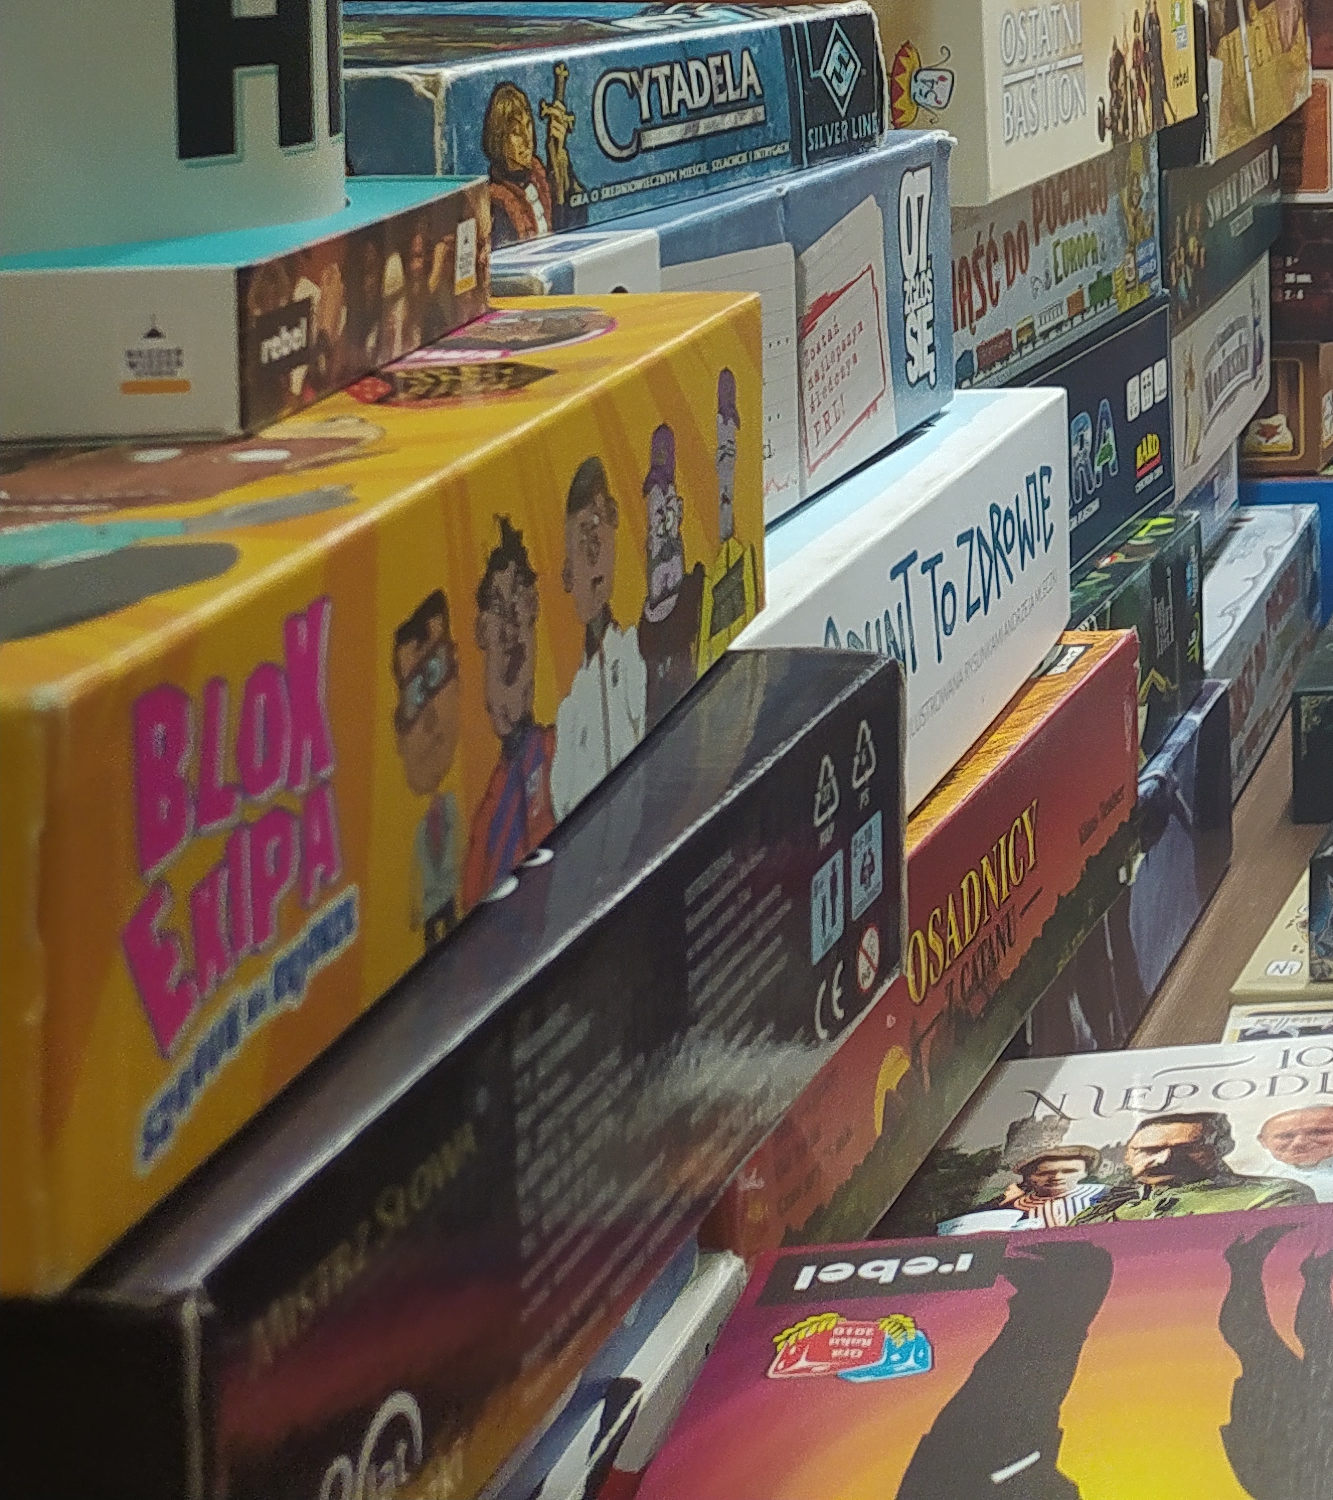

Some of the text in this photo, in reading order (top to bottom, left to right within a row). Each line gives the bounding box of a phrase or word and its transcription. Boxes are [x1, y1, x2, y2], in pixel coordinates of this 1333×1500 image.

[1001, 0, 1083, 67] OSTATNI
[592, 49, 763, 161] CYTADELA
[806, 121, 849, 153] SILVER
[1003, 63, 1088, 146] BASTION
[1002, 219, 1030, 290] DO
[956, 464, 1054, 625] ZDROWIE
[132, 594, 335, 881] BLOK
[121, 782, 342, 1061] EKIPA
[906, 799, 1039, 1008] OSADNICY
